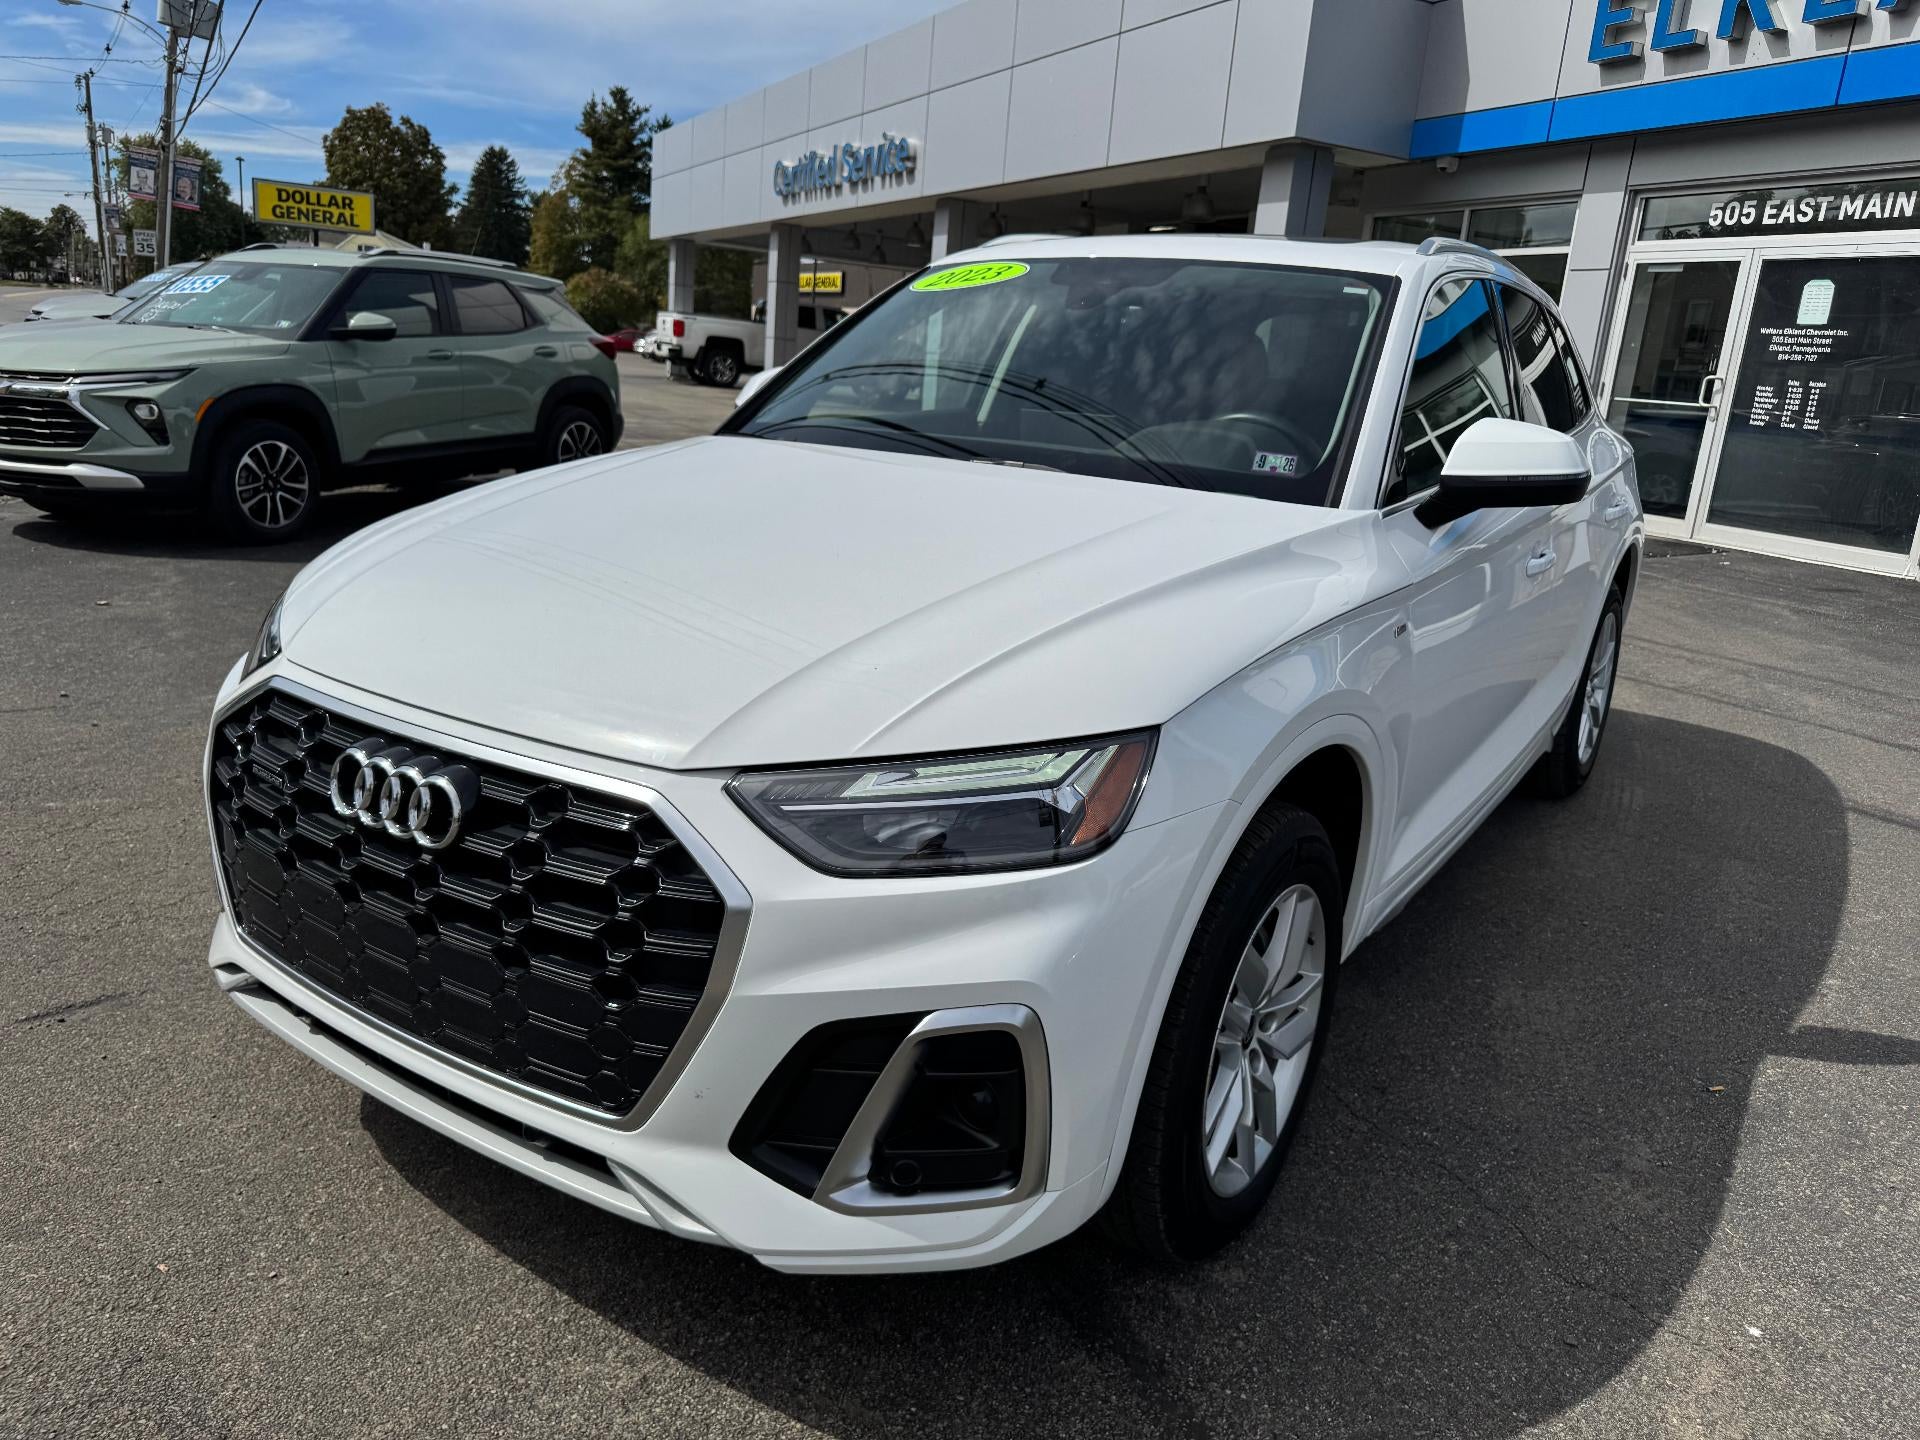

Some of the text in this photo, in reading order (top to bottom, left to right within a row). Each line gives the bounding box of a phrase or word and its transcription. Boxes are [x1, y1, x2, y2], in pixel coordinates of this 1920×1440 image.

[774, 131, 911, 197] Certified Service
[276, 187, 354, 211] DOLLAR
[1708, 191, 1918, 226] 505 EAST MAIN
[272, 204, 360, 227] GENERAL
[136, 243, 155, 254] 35
[923, 265, 1013, 288] 2023
[1784, 336, 1797, 344] East
[1792, 345, 1831, 354] Pennsylvania
[1258, 454, 1294, 472] 9 26
